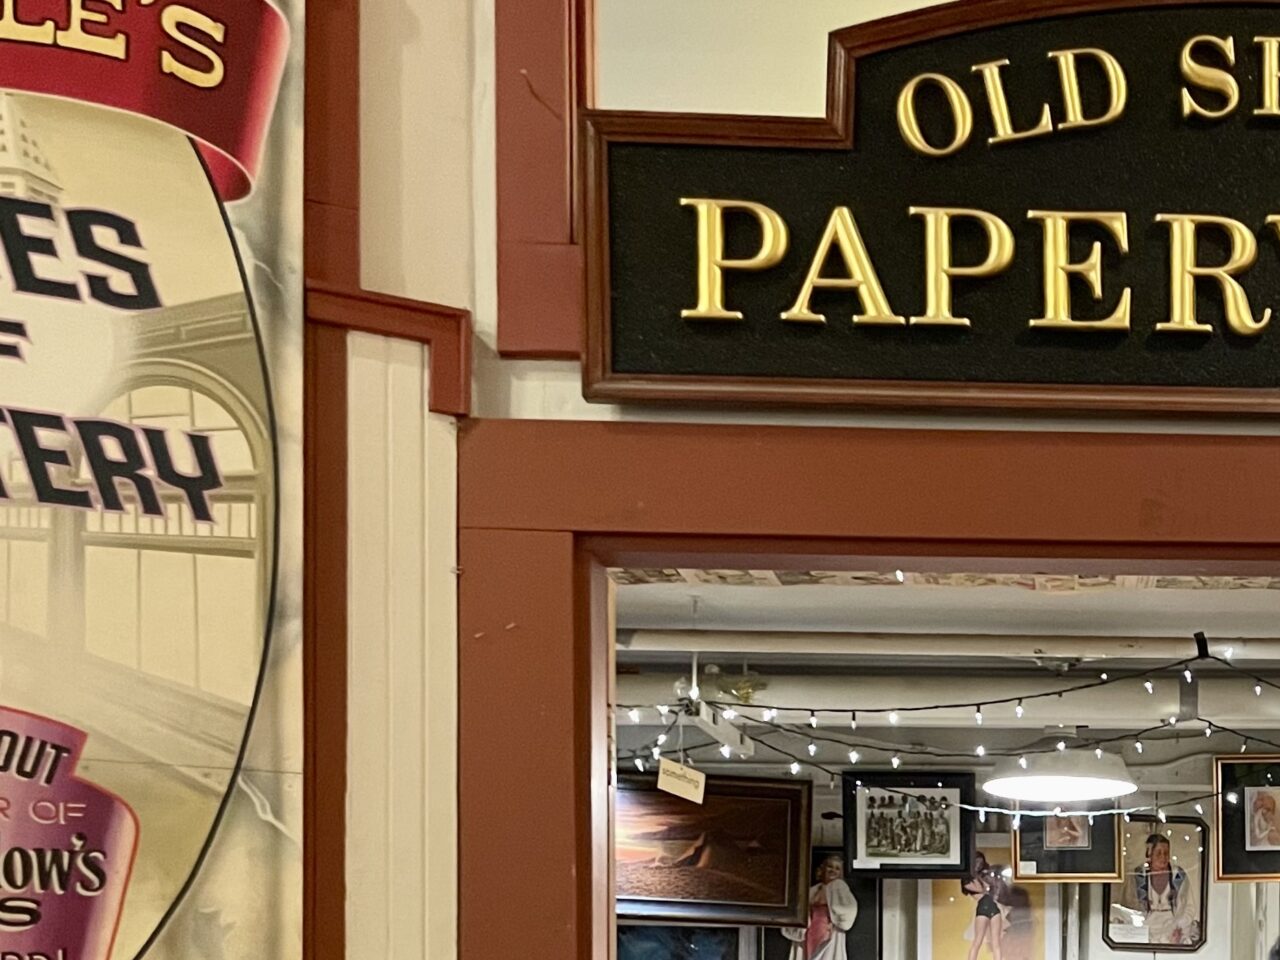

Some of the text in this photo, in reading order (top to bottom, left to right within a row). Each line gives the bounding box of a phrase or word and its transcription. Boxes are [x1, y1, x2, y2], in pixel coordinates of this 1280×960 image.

[0, 0, 225, 88] LES
[897, 47, 1127, 156] OLD
[0, 407, 223, 522] ERY
[29, 801, 87, 825] OF
